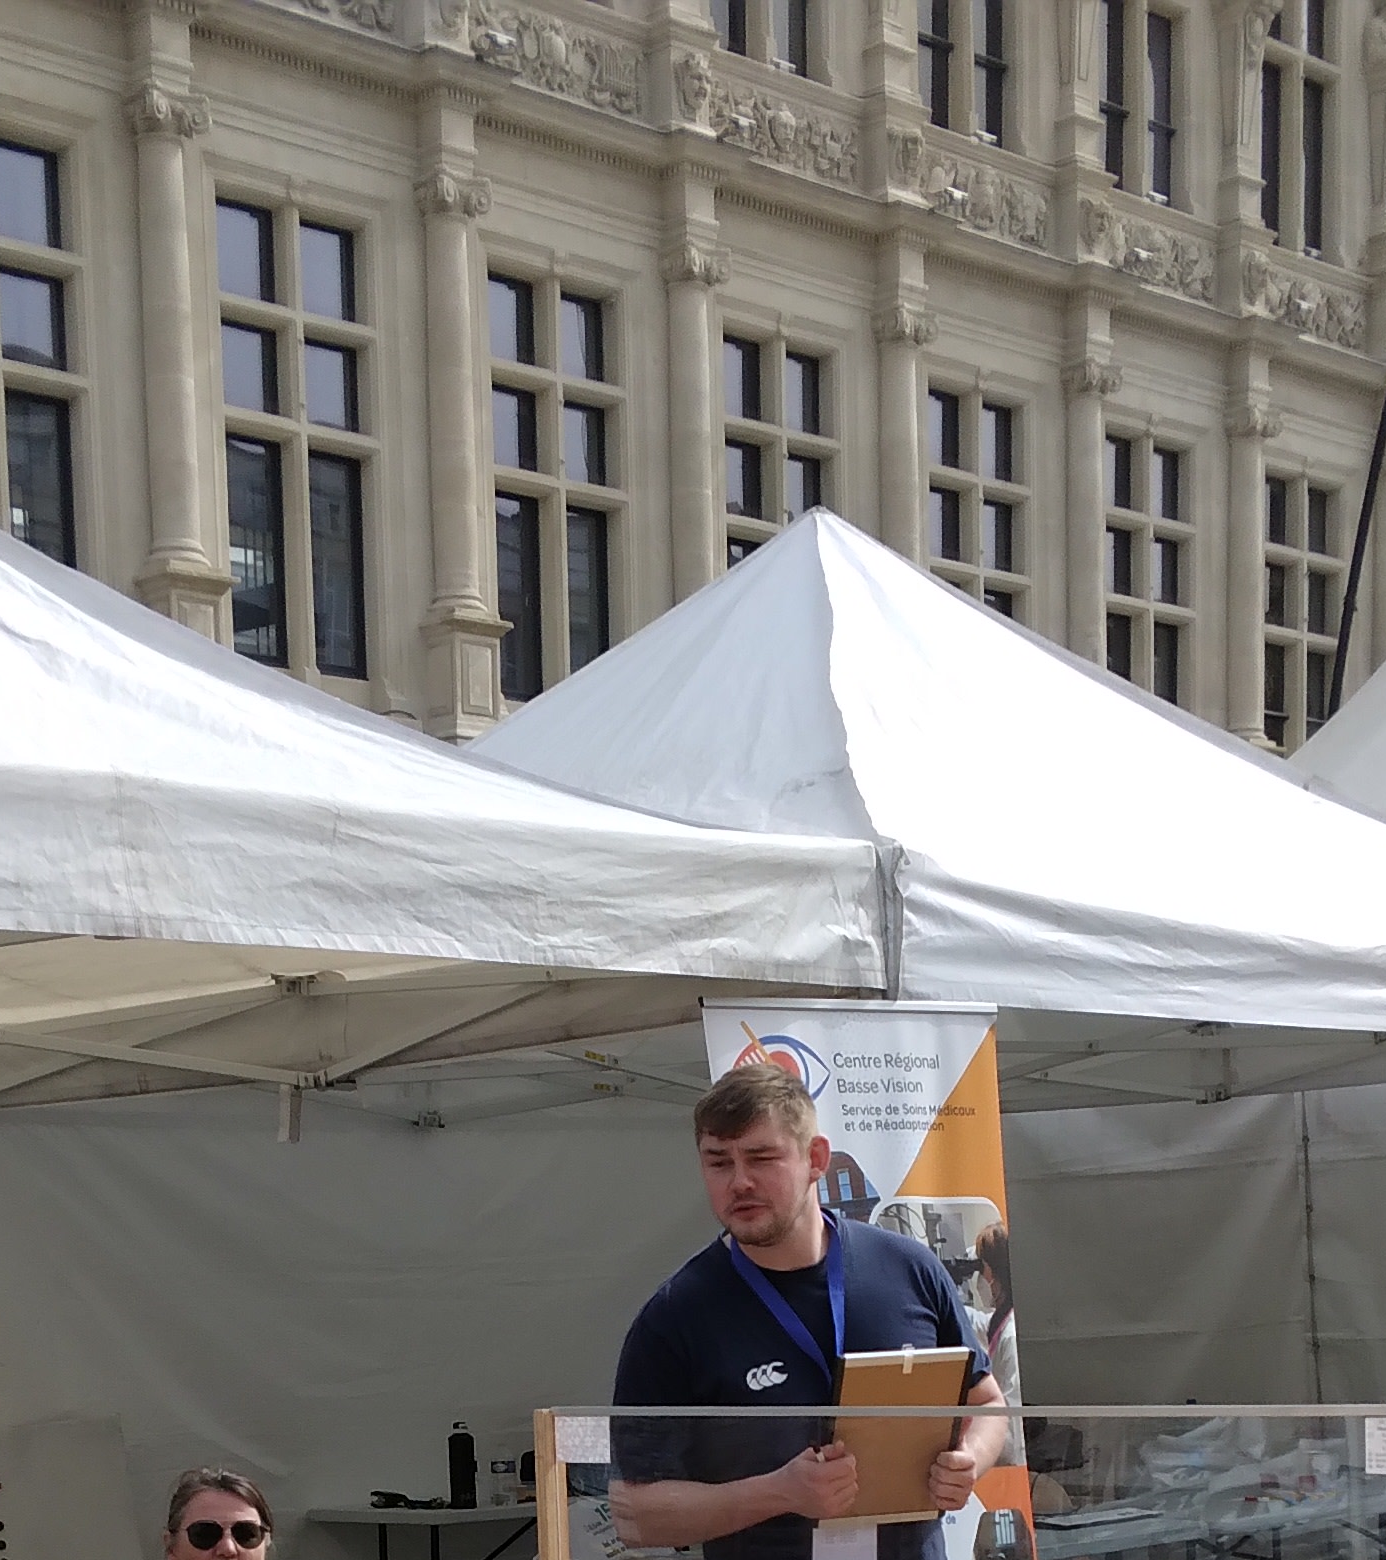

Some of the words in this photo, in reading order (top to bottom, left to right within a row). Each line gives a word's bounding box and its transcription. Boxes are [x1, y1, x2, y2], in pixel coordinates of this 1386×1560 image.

[833, 1052, 882, 1069] Centre
[884, 1052, 940, 1073] Régional
[836, 1078, 879, 1094] Basse
[880, 1078, 924, 1093] Vision
[841, 1104, 882, 1116] Service
[884, 1103, 900, 1115] de
[902, 1103, 928, 1115] Soins
[929, 1104, 976, 1116] Médicaux
[844, 1120, 856, 1131] et
[858, 1120, 872, 1131] de
[875, 1119, 945, 1132] Réadaptation
